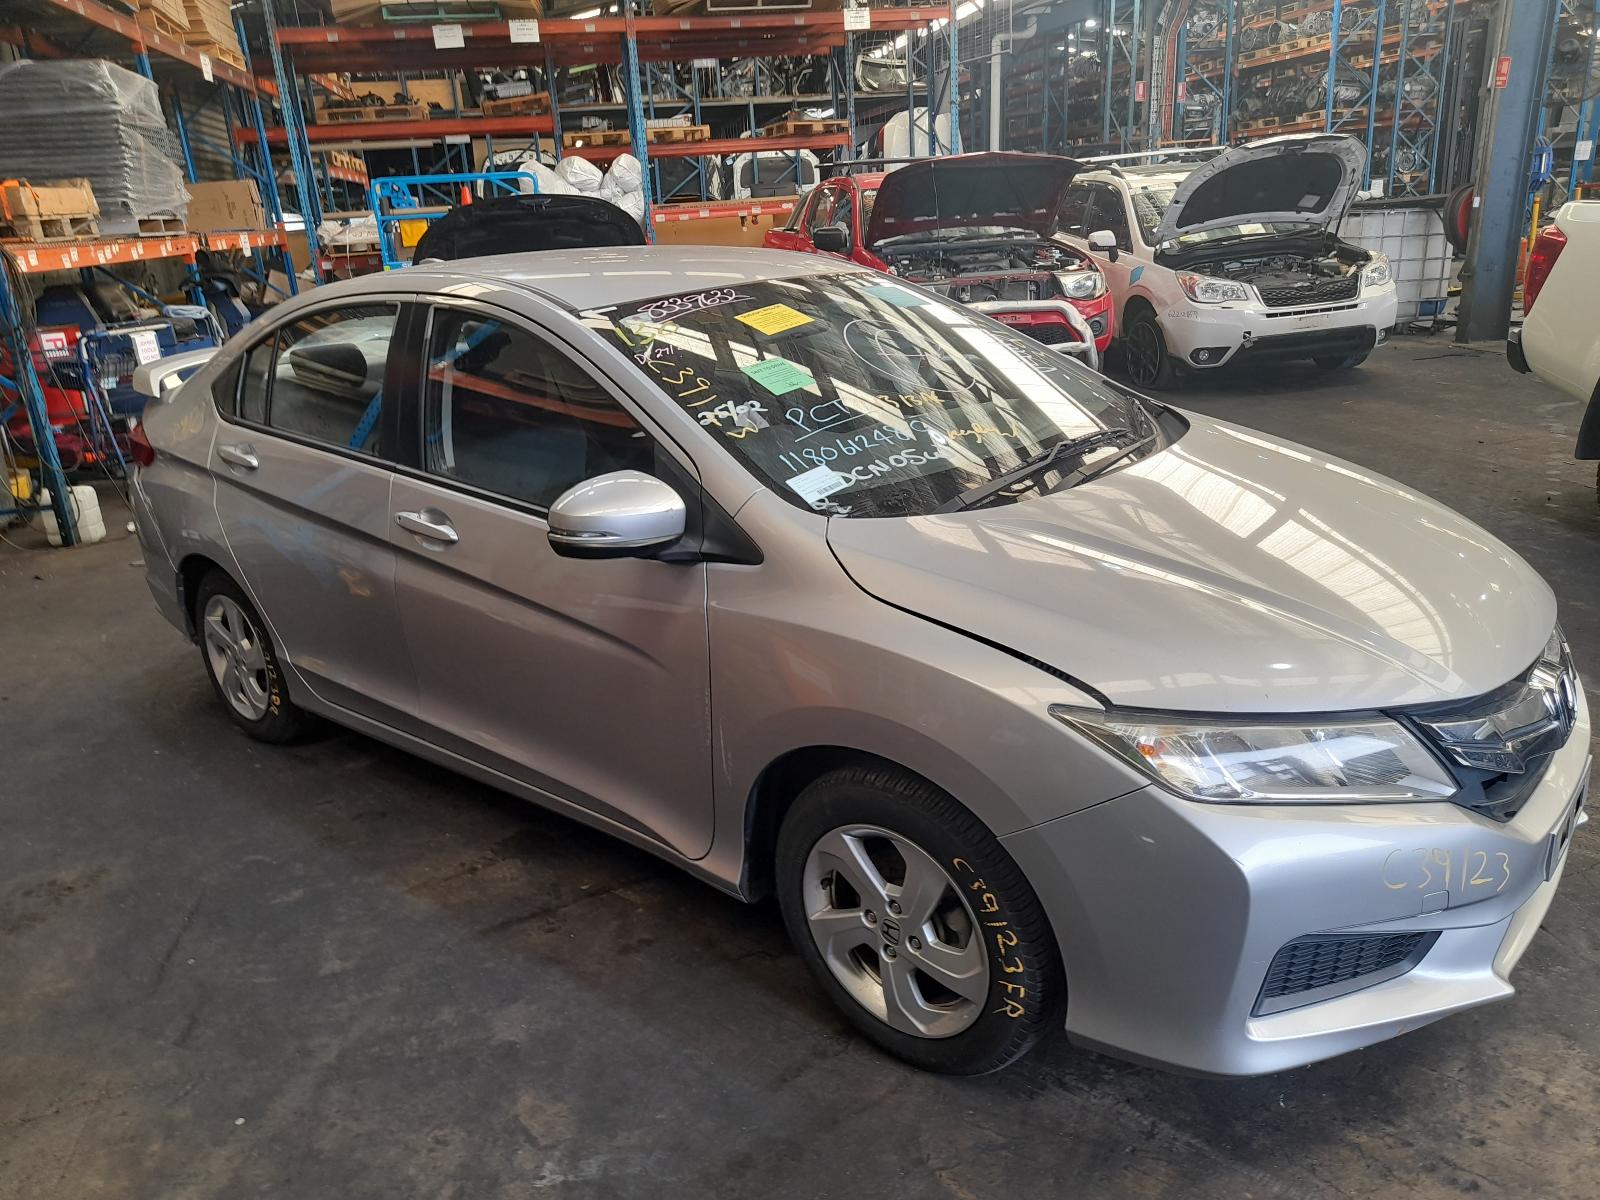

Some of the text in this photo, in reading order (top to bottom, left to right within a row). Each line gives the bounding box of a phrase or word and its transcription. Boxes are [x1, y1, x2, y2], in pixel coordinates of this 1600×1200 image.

[637, 288, 752, 319] 8339632
[784, 397, 852, 433] PCT
[1383, 847, 1511, 893] C39123
